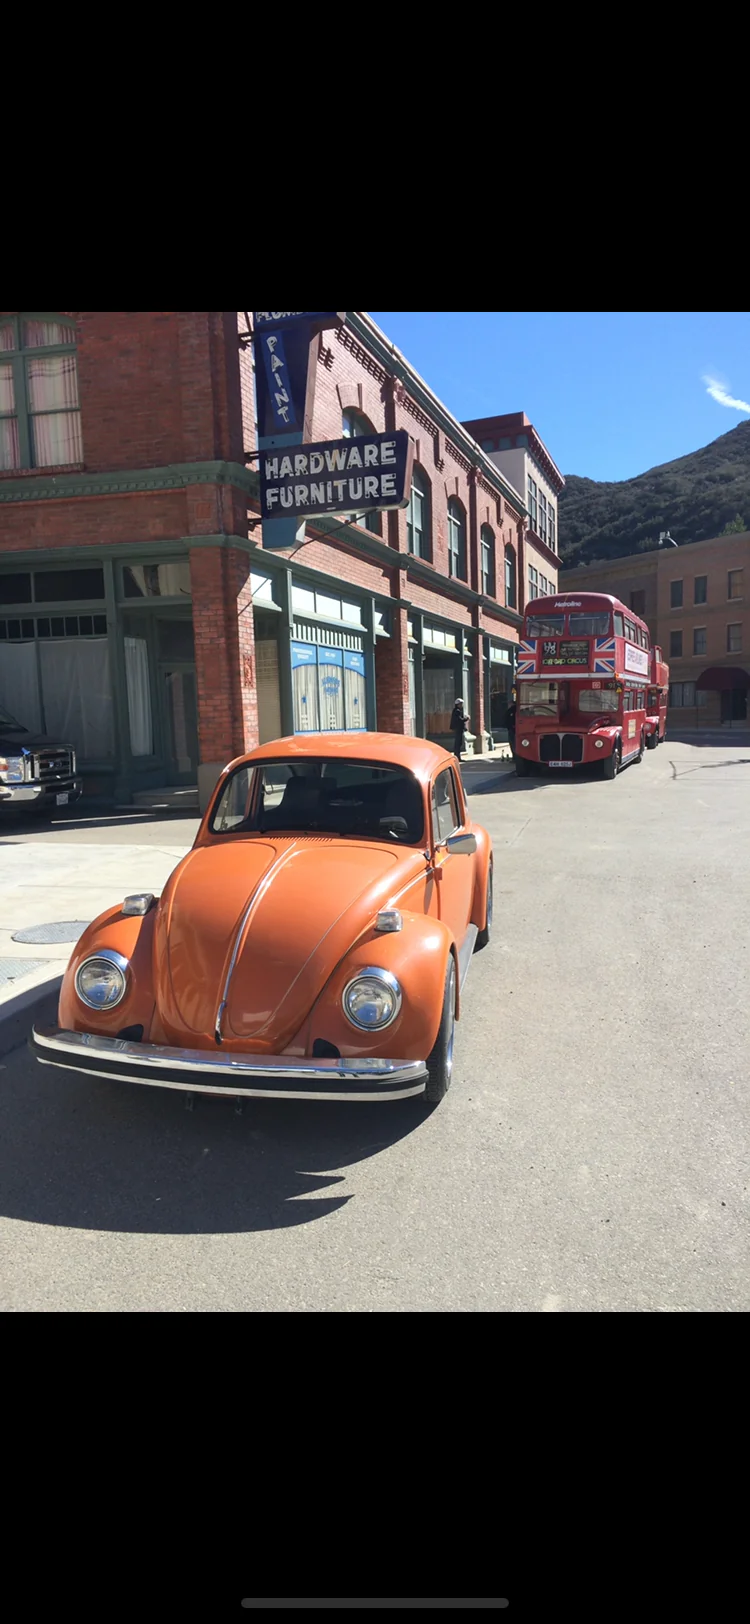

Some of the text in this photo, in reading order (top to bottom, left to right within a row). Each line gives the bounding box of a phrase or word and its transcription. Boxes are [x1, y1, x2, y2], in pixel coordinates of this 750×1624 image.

[266, 336, 290, 423] PAINT
[265, 441, 396, 480] HARDWARE
[265, 473, 397, 510] FURNITURE
